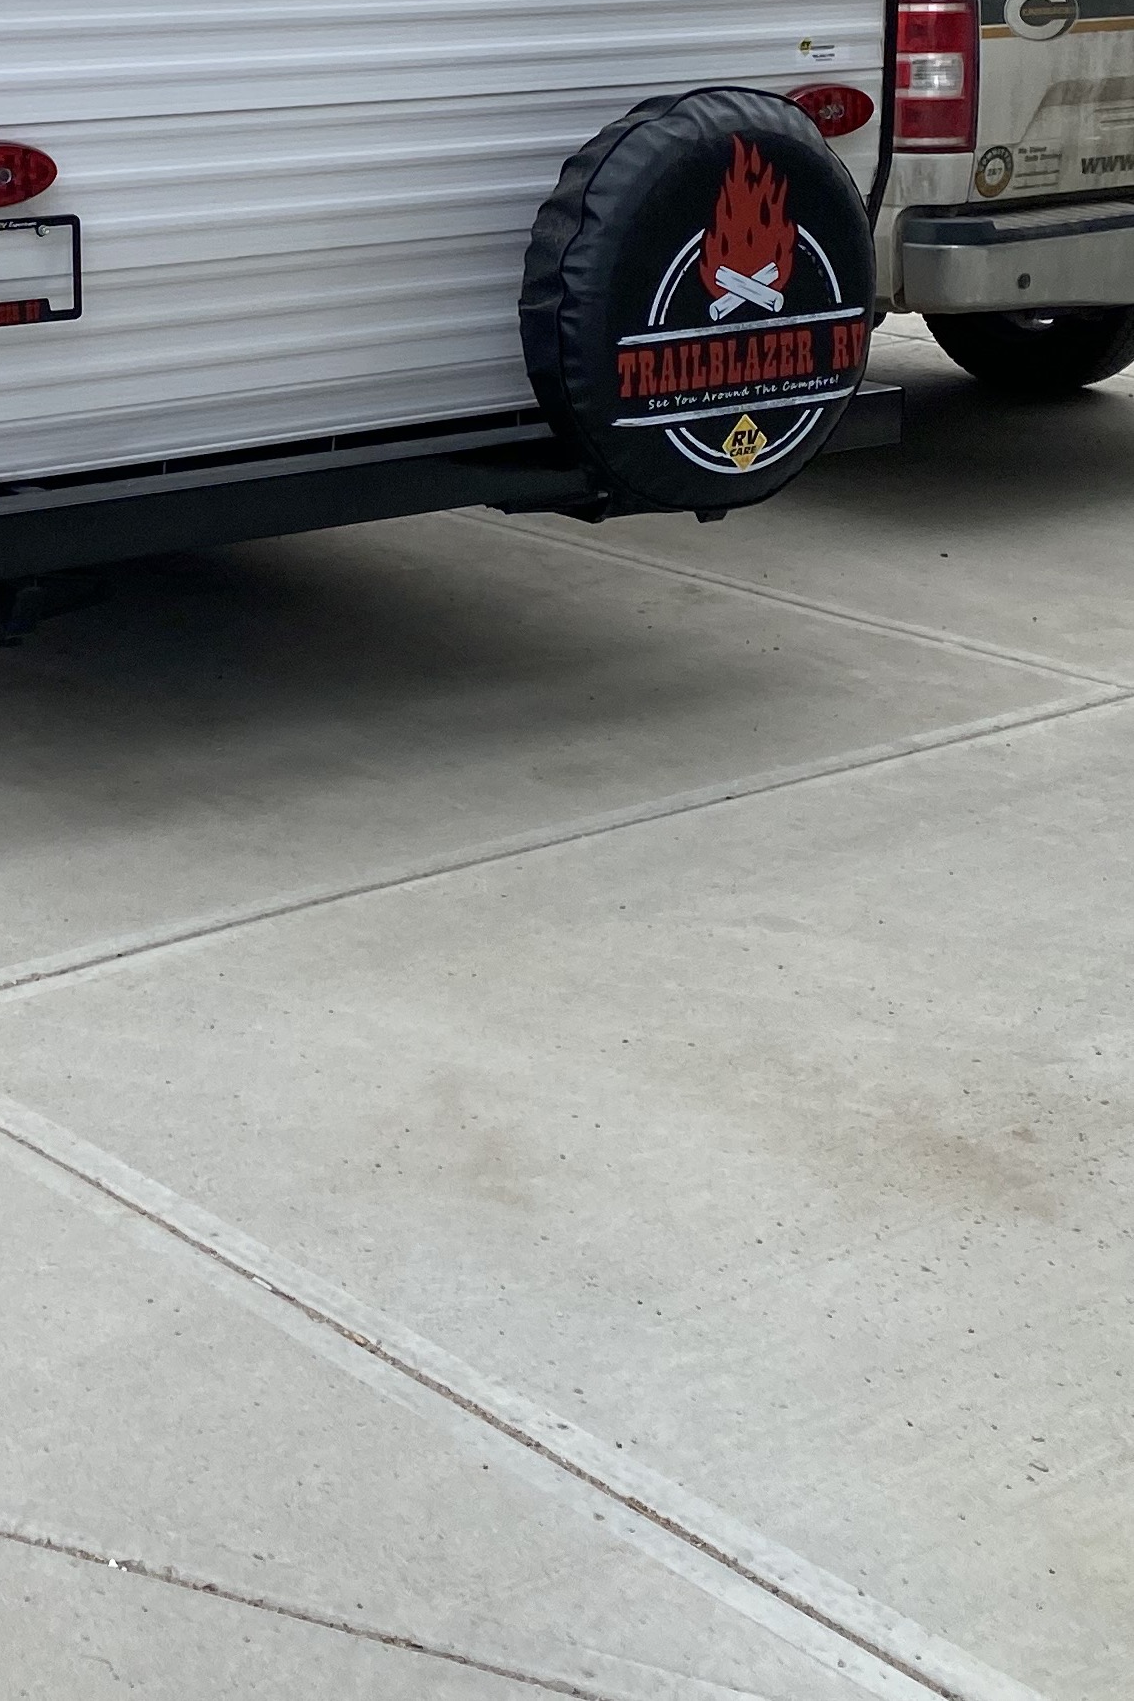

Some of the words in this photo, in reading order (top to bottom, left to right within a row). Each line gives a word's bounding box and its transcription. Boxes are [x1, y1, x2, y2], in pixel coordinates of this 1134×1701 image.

[617, 330, 814, 398] TRAILBLAZER
[832, 321, 866, 370] RV
[648, 399, 670, 410] See
[674, 394, 698, 407] You
[702, 388, 750, 402] Around
[755, 383, 777, 395] The
[782, 374, 840, 391] Campfire!
[732, 429, 759, 446] RV
[730, 446, 756, 456] CARE
